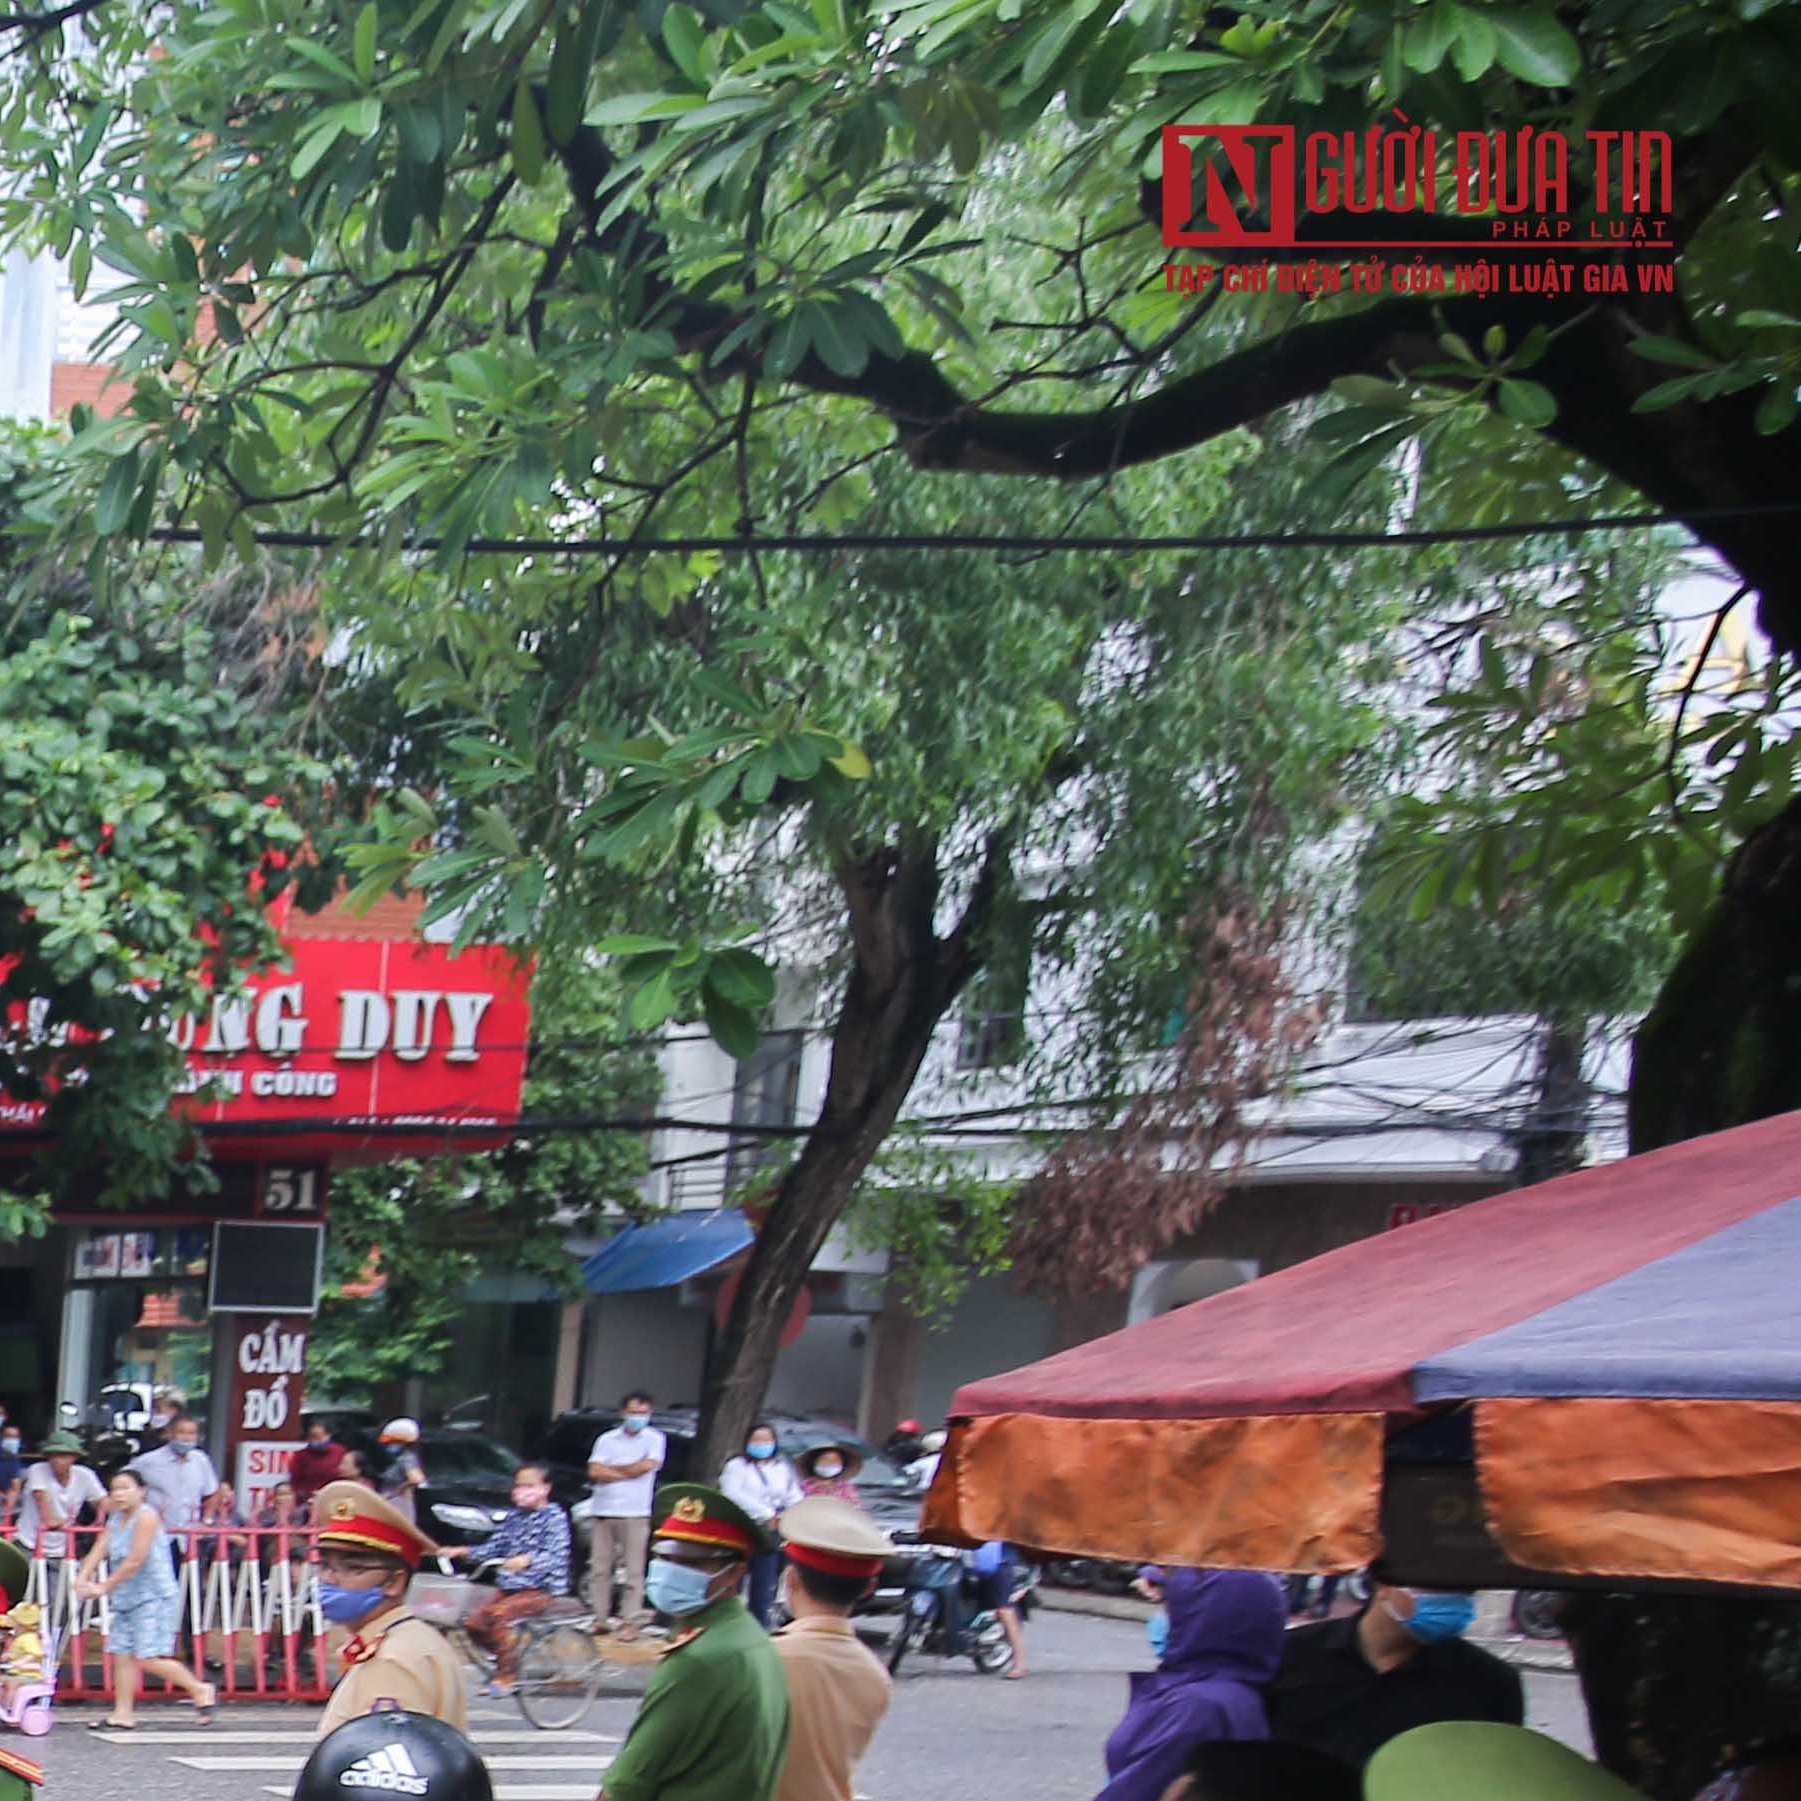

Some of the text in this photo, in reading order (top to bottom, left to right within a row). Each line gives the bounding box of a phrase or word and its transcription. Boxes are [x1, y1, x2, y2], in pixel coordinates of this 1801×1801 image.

[334, 988, 494, 1064] DUY
[264, 1168, 318, 1210] 51
[338, 1767, 431, 1797] adidas
